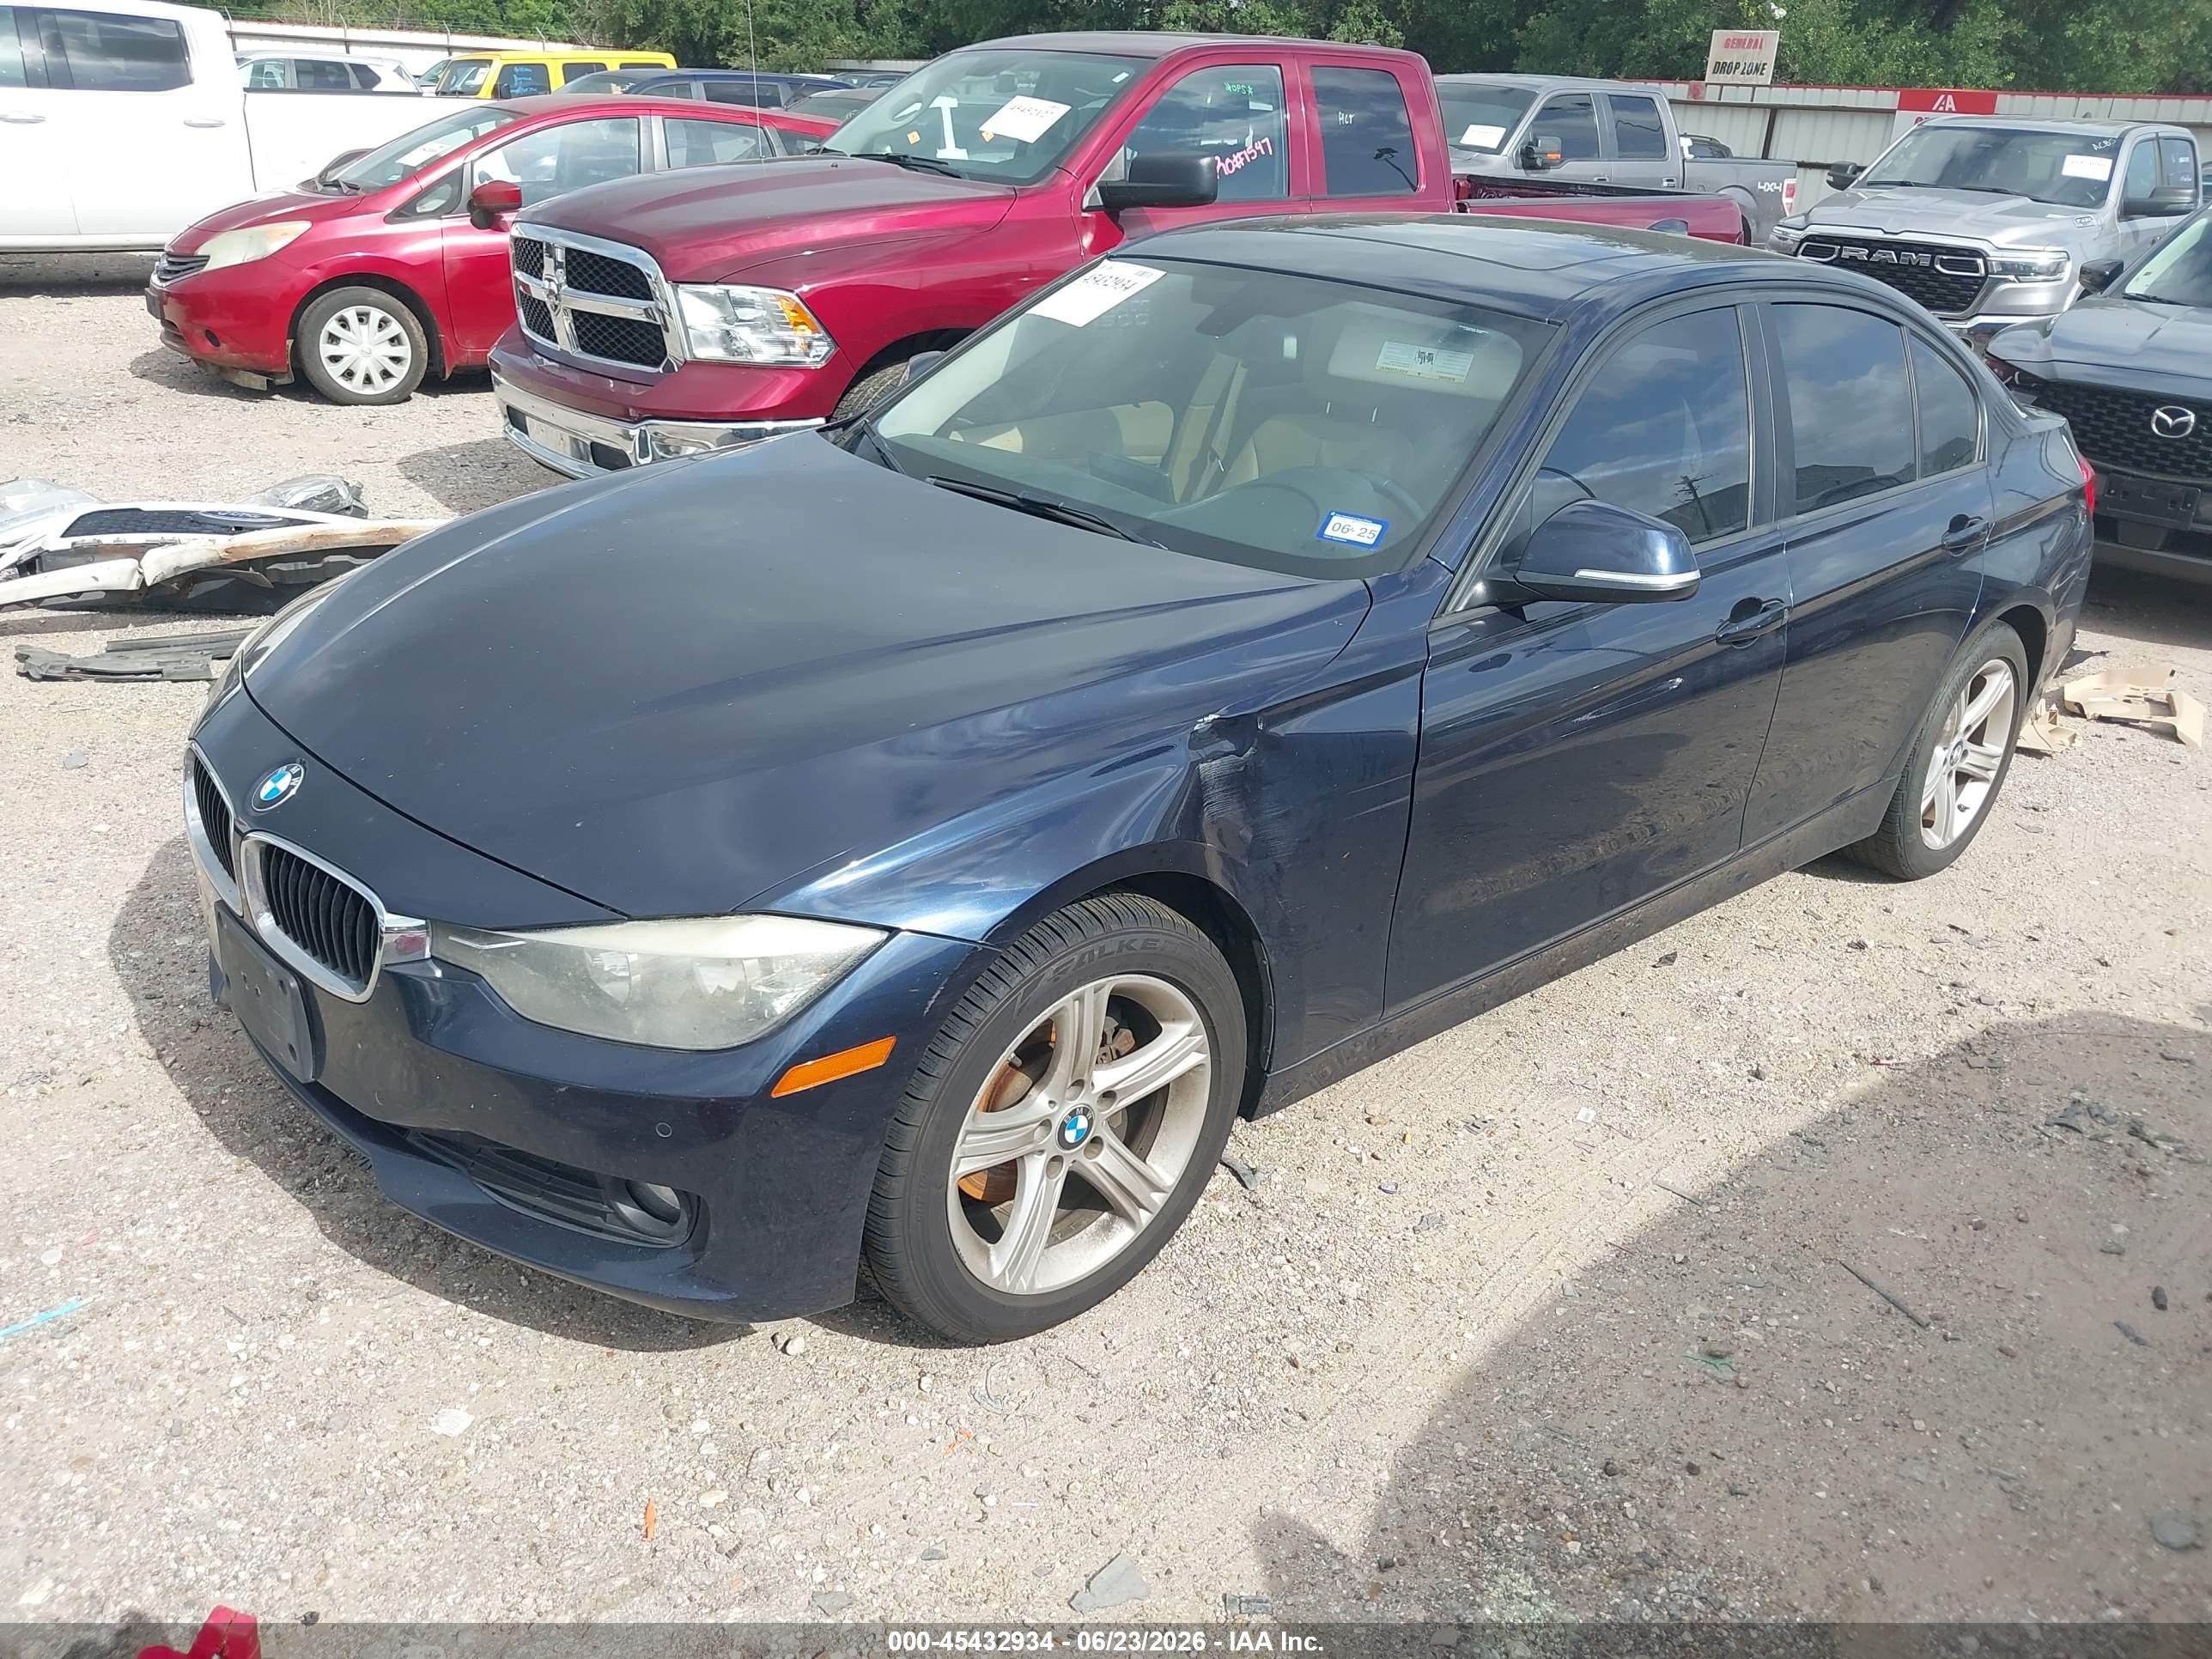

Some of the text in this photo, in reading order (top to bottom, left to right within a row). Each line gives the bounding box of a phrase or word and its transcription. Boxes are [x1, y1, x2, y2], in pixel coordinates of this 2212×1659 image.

[1723, 37, 1764, 50] GENERAL
[1711, 61, 1768, 76] DROP ZONE
[1840, 246, 1932, 267] RAM
